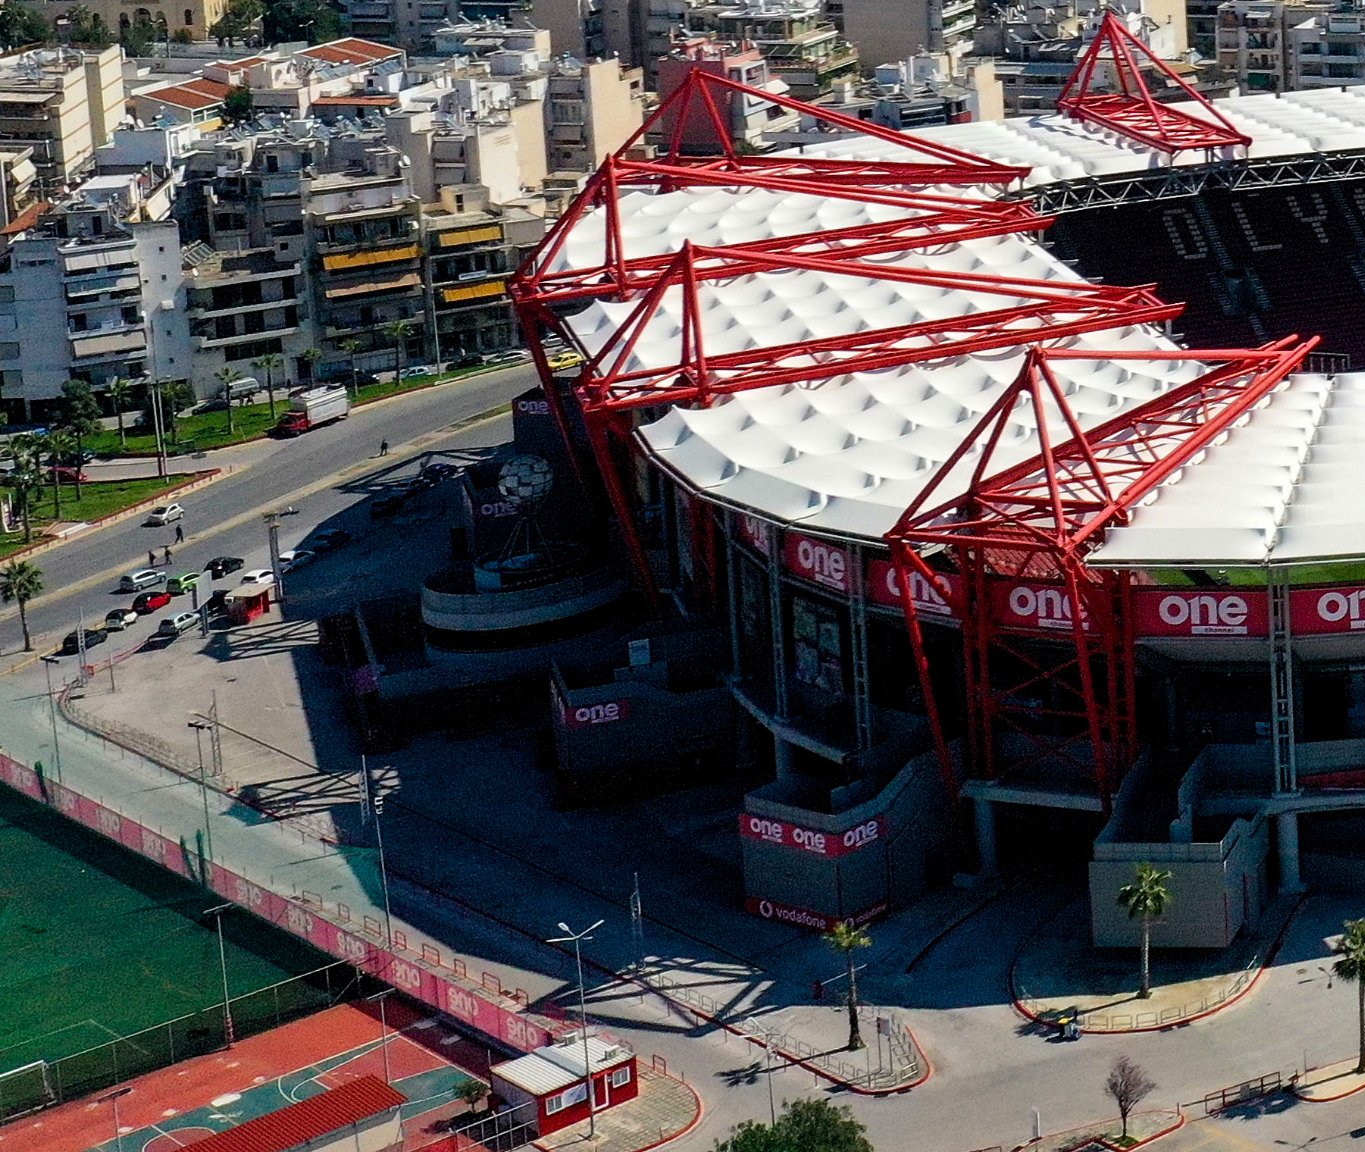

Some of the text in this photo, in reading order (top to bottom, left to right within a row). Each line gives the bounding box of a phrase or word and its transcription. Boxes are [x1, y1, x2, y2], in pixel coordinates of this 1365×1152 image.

[800, 541, 844, 580] one
[1159, 595, 1248, 625] one
[575, 703, 619, 721] one
[750, 818, 826, 848] one one
[843, 820, 878, 846] one
[776, 907, 826, 929] vodafone
